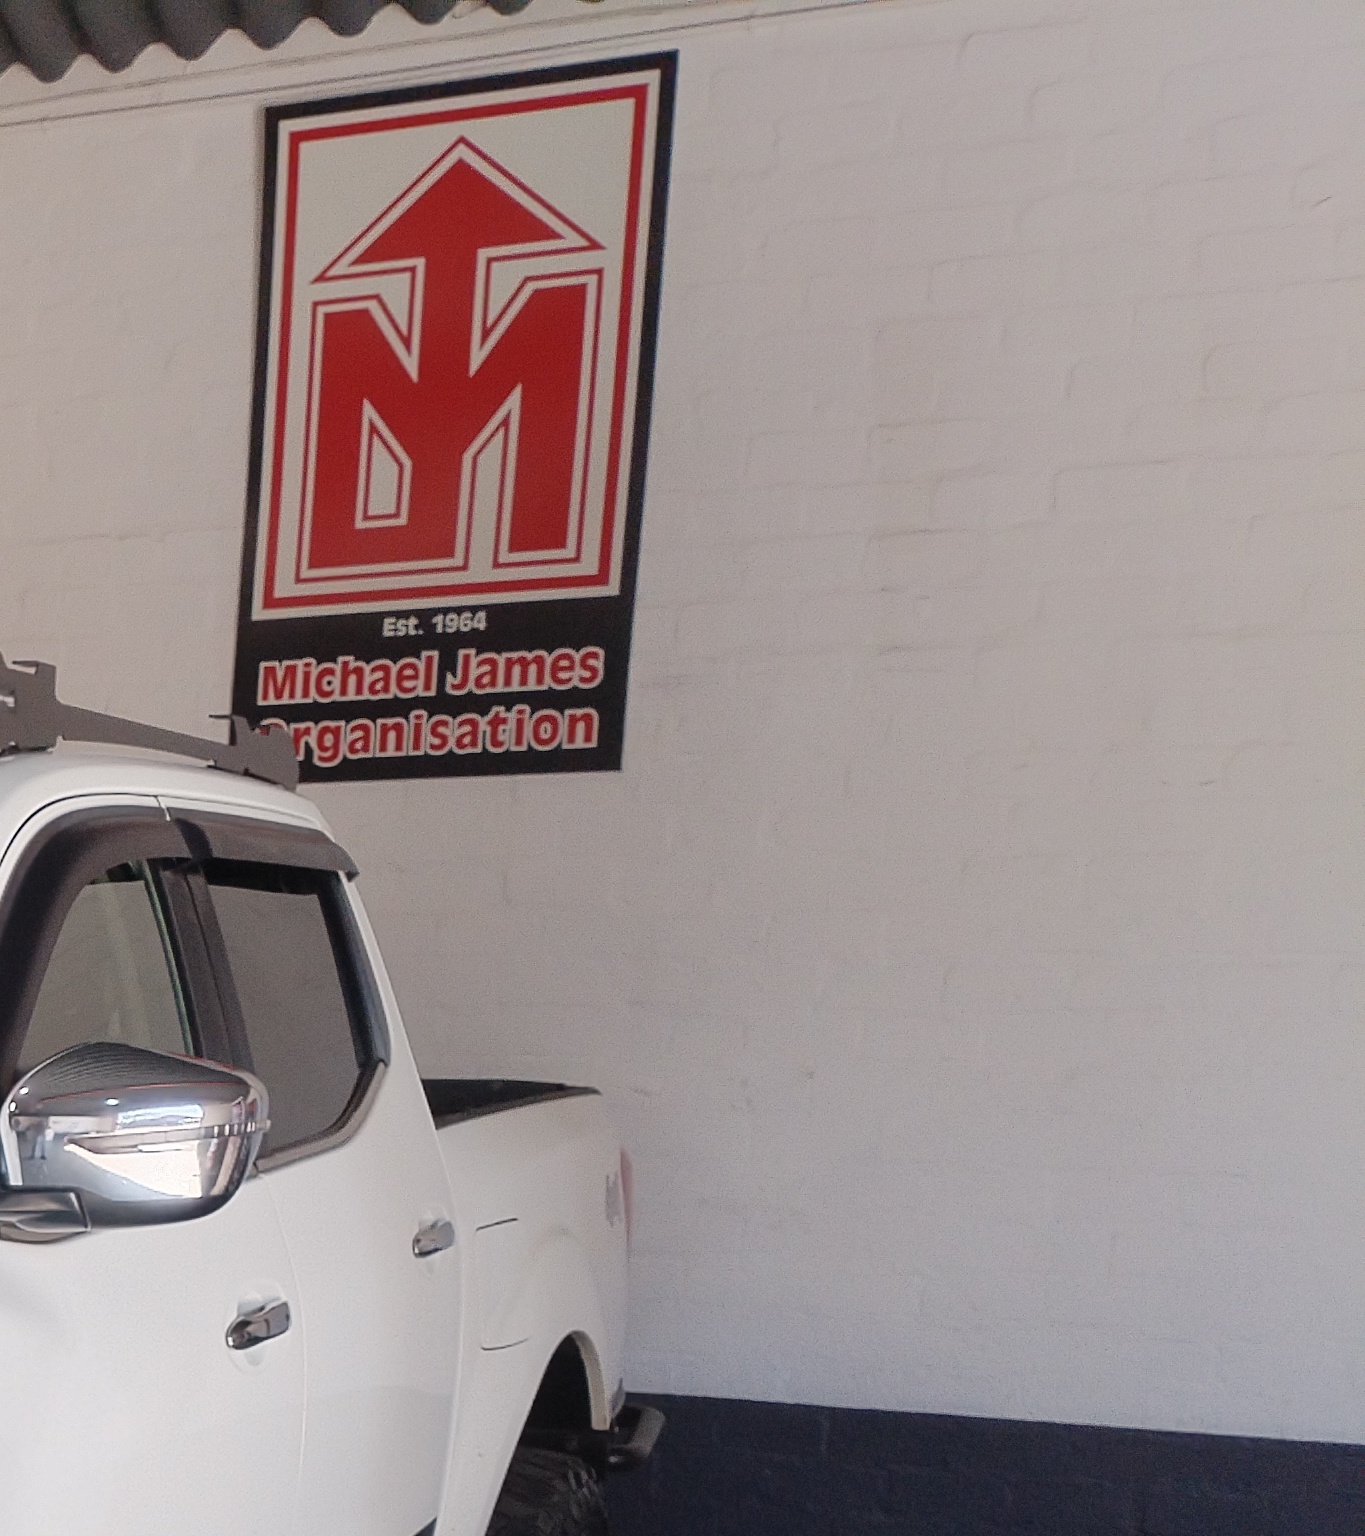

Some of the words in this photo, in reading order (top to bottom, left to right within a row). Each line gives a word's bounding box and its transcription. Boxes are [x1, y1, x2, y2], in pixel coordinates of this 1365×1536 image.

[382, 616, 424, 638] Est.
[431, 610, 488, 634] 1964
[257, 649, 440, 706] Michael
[445, 645, 605, 695] James
[255, 703, 600, 768] rganisation
